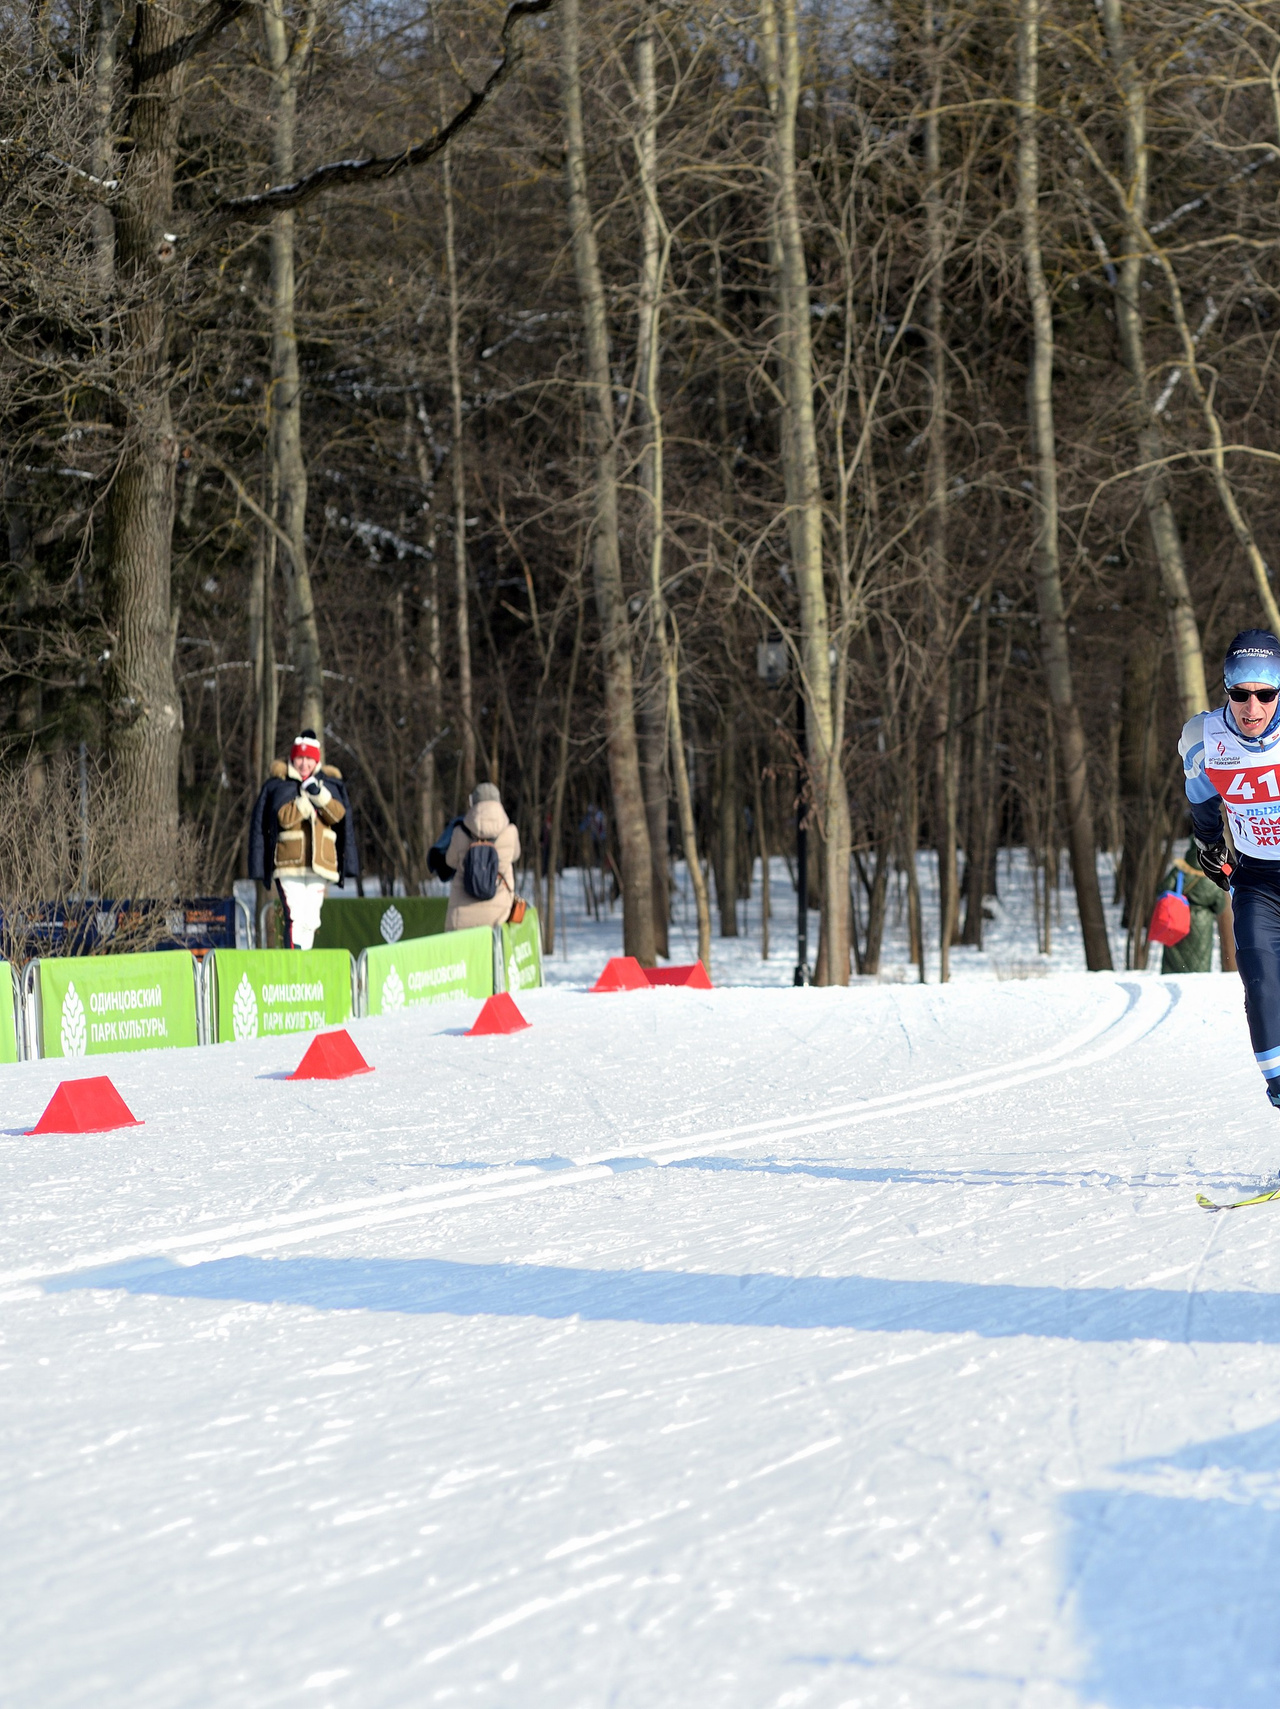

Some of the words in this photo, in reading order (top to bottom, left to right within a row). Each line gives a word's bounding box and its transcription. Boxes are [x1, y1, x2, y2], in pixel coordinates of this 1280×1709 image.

[89, 984, 163, 1016] ОДИНЦОВСКИЙ
[90, 1021, 118, 1043] ПАРК
[118, 1017, 168, 1041] КУЛЬТУРЫ,
[263, 1011, 284, 1031] ПАРК
